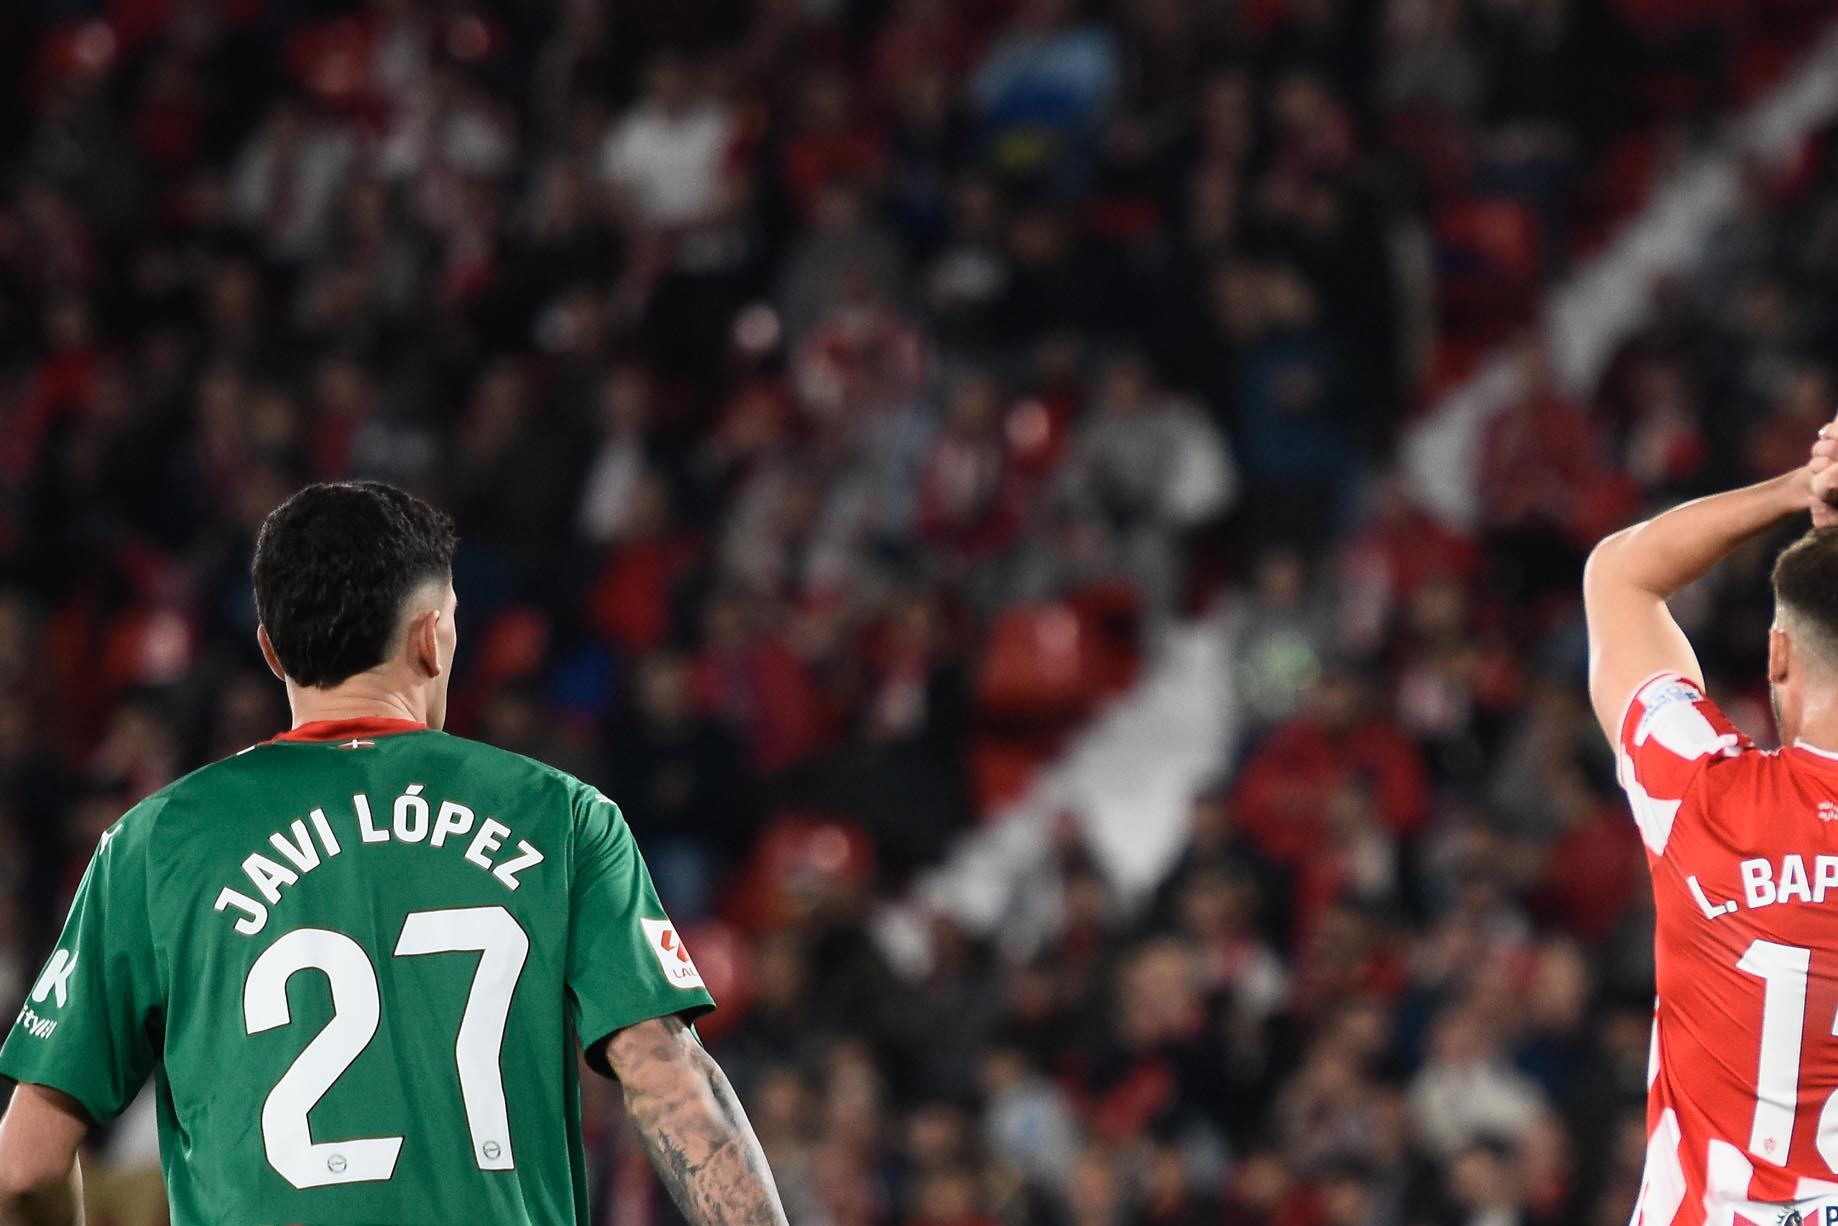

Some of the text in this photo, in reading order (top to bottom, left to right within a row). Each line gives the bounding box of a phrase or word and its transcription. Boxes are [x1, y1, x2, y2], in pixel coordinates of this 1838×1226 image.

[213, 784, 545, 936] JAVI LÓPEZ
[1686, 875, 1739, 920] L.
[243, 905, 530, 1190] 27
